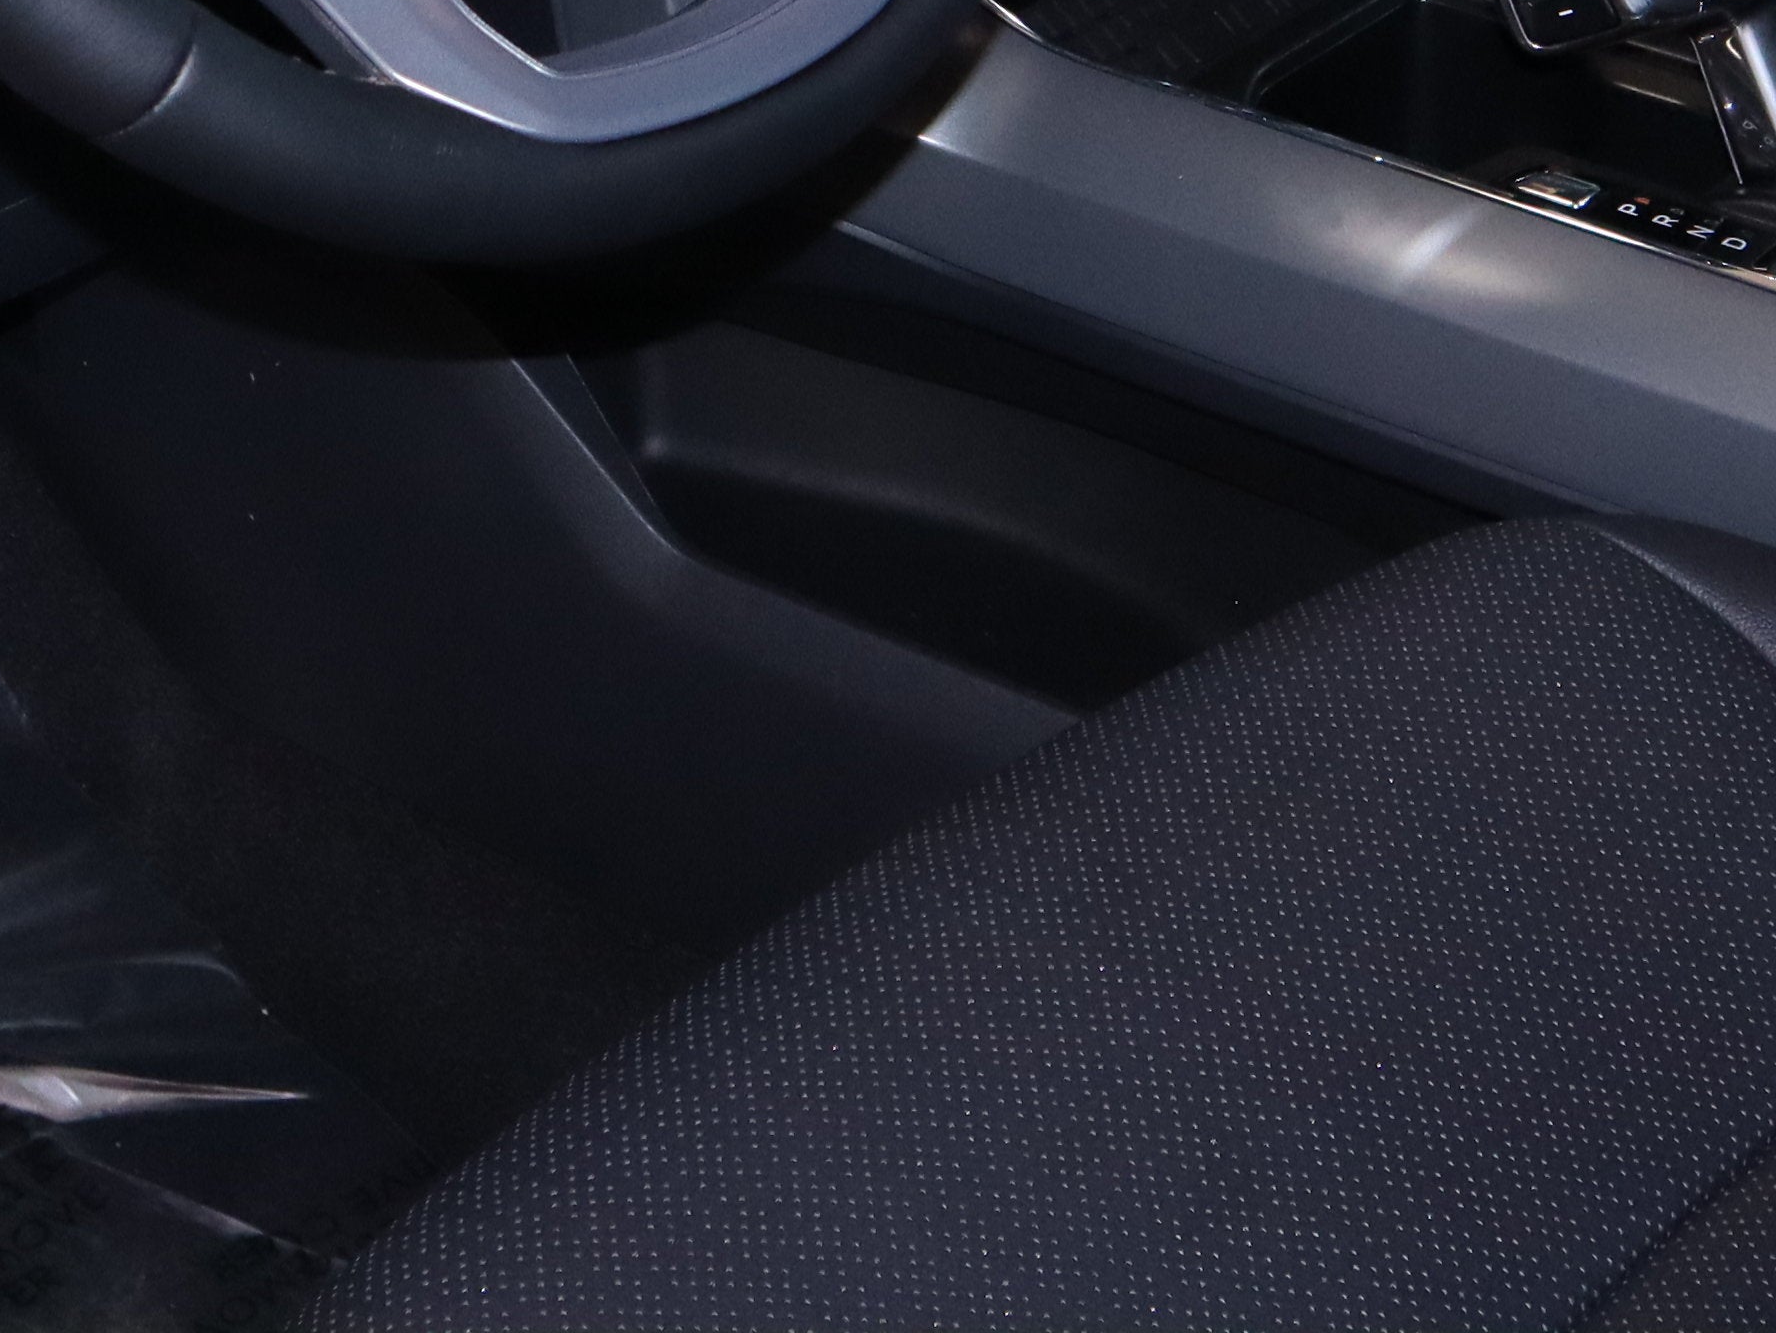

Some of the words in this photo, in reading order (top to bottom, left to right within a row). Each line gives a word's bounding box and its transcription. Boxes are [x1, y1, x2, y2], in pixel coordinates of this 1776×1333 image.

[1617, 203, 1639, 217] P
[1652, 214, 1679, 228] R
[1686, 224, 1715, 240] N
[1721, 237, 1748, 251] D
